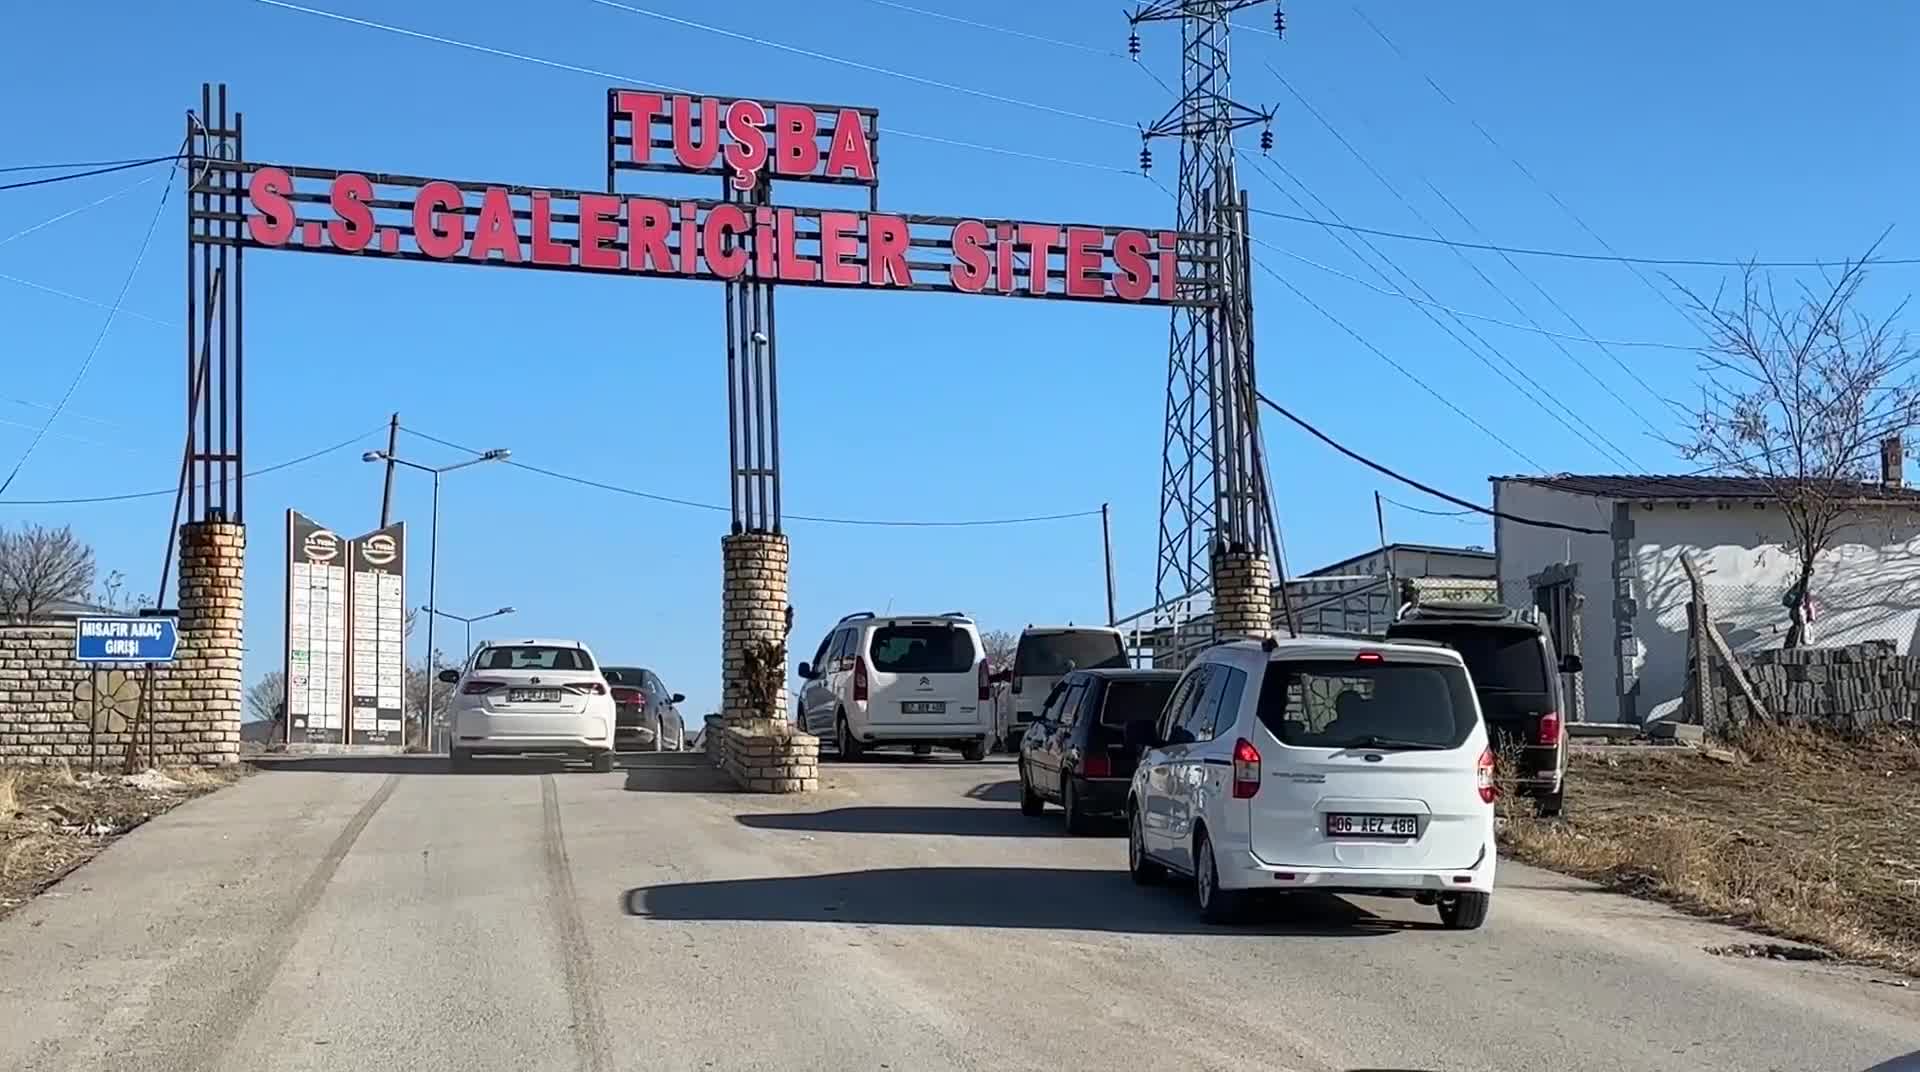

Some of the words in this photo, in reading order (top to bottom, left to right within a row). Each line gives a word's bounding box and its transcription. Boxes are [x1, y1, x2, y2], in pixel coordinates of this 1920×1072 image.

[617, 91, 875, 190] TUŞBA
[1336, 816, 1353, 832] 06
[1361, 817, 1385, 833] AEZ
